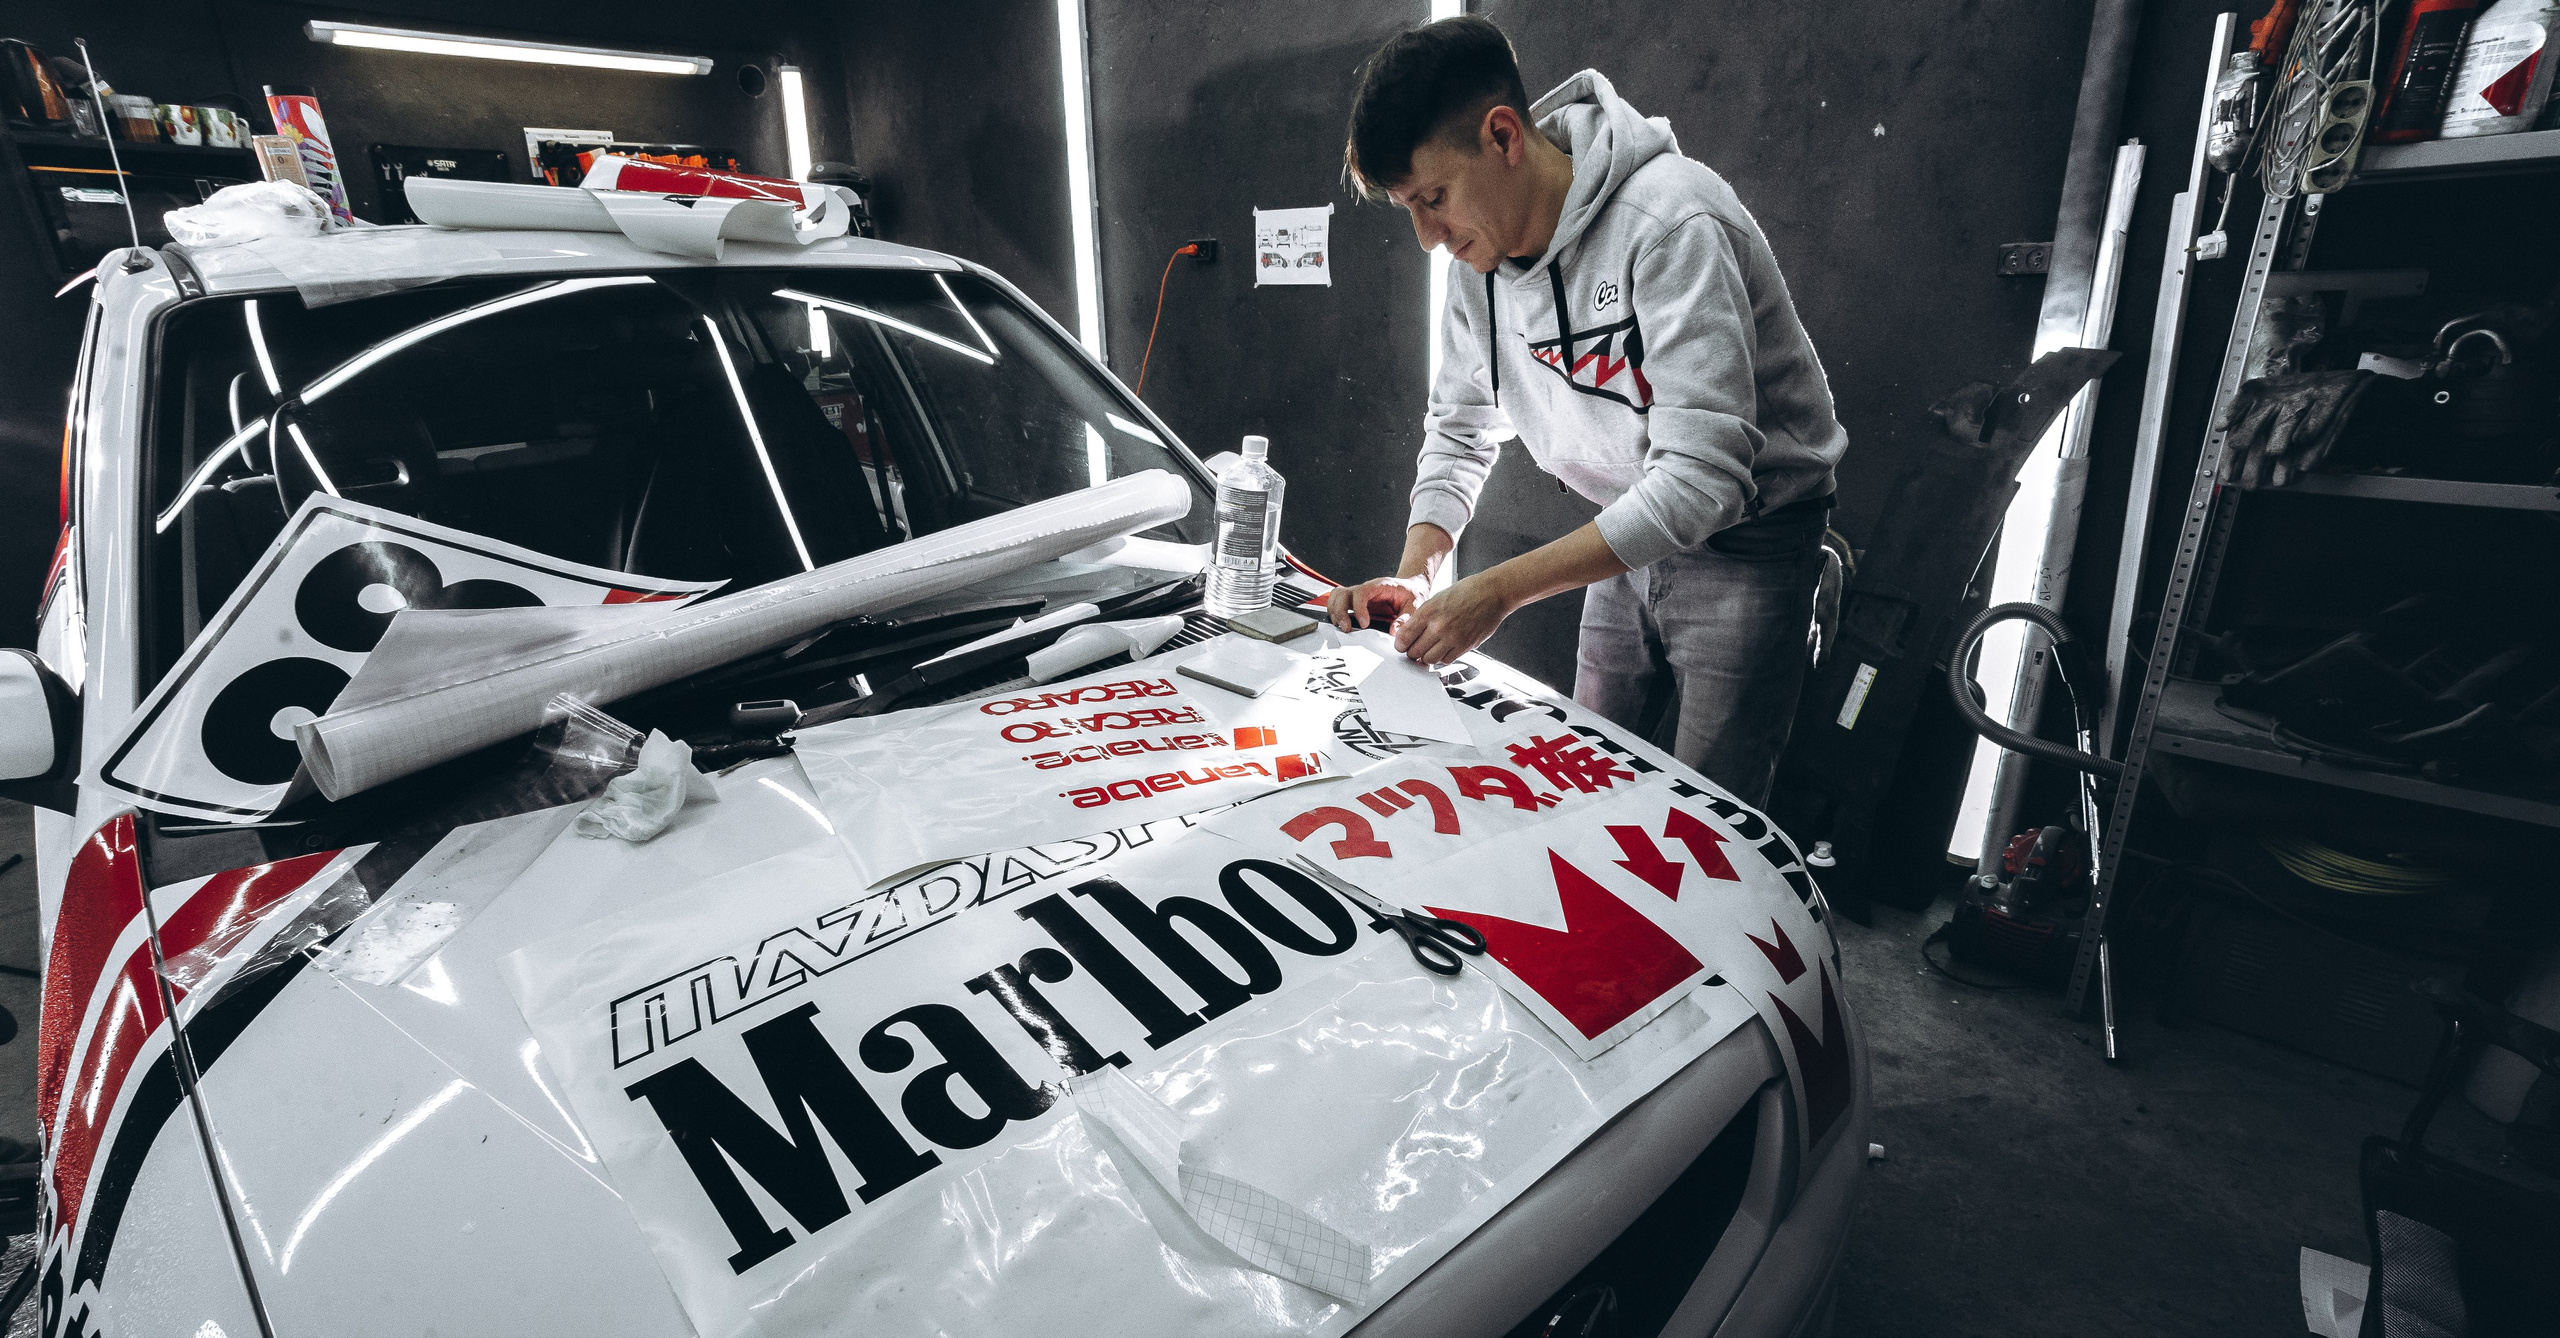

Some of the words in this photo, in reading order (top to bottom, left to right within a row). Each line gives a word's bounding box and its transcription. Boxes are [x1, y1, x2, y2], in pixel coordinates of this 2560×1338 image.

[433, 159, 456, 169] SATA
[979, 677, 1179, 717] RECARO
[1000, 703, 1206, 744] RECARO
[623, 858, 1394, 1276] Marlbo
